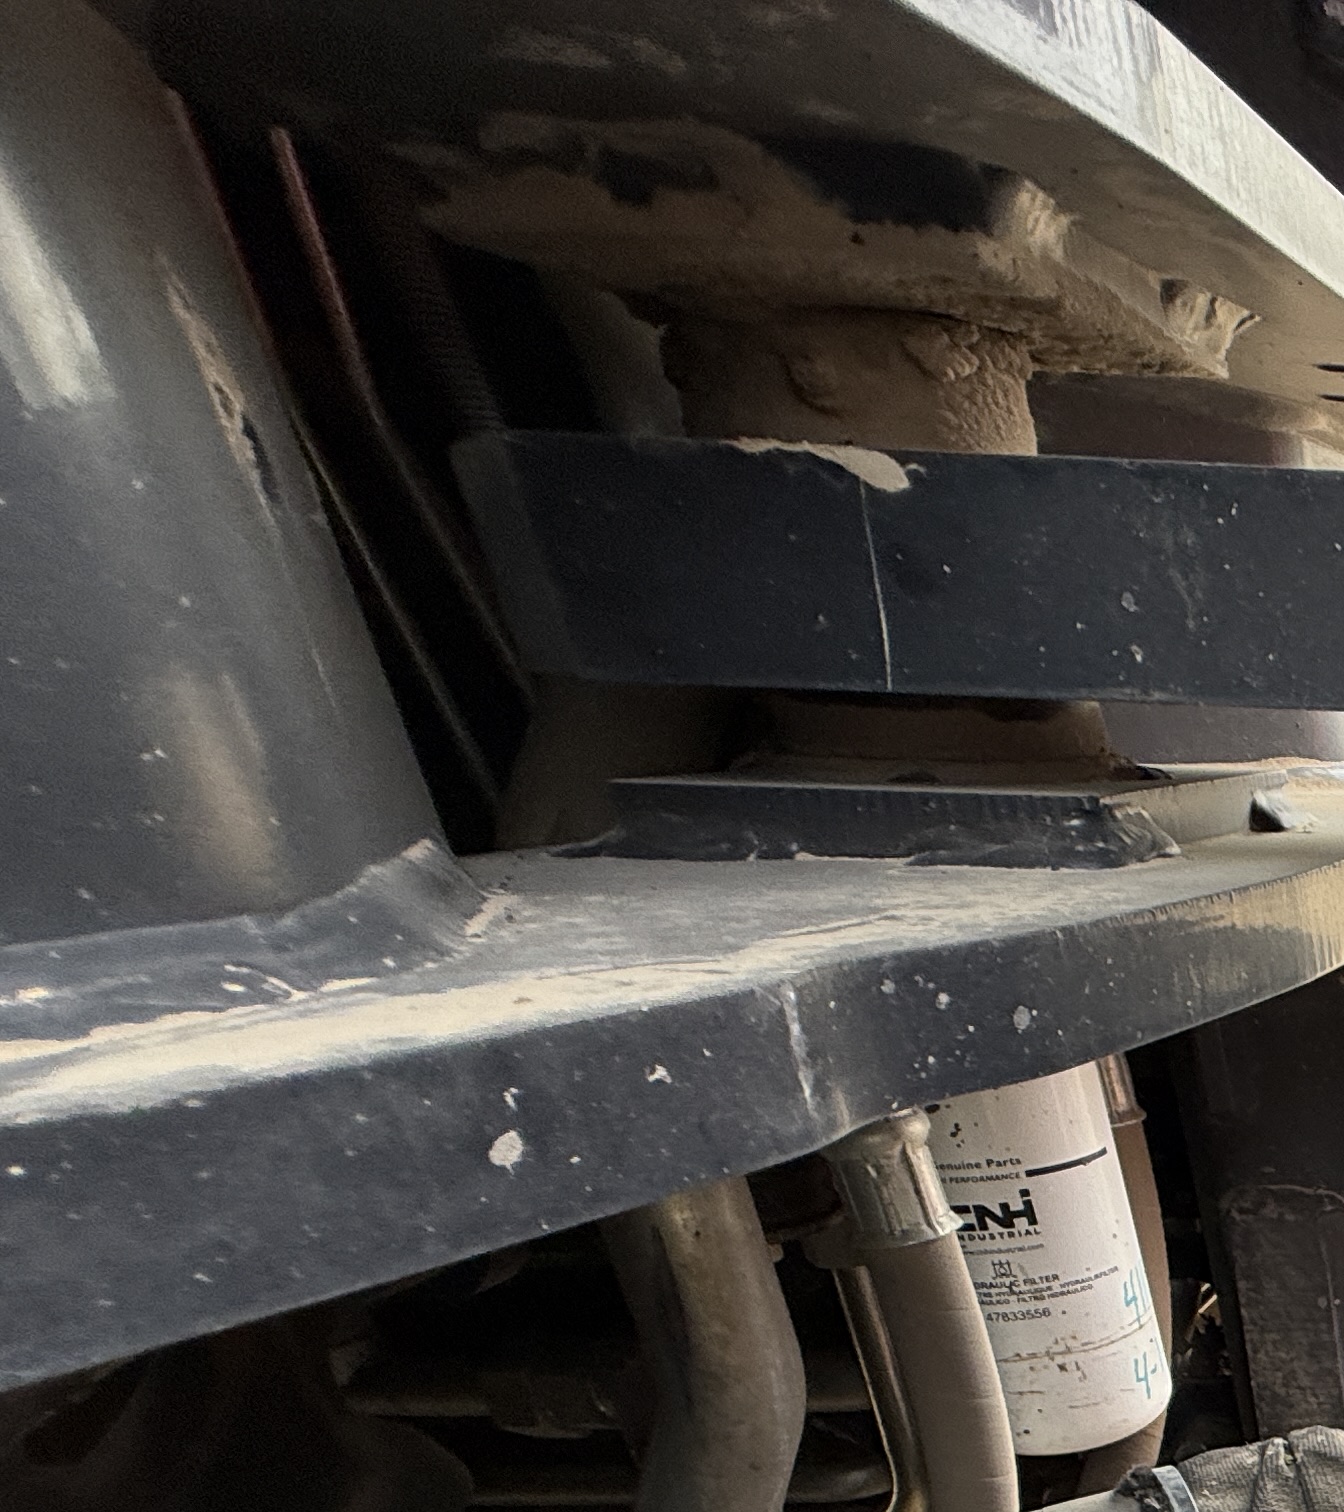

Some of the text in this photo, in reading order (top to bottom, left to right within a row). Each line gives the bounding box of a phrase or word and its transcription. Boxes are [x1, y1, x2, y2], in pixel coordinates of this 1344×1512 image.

[985, 1156, 1022, 1169] Parts
[949, 1172, 1021, 1184] PERFORMANCE
[957, 1227, 1042, 1242] NDUSTRIAL
[1023, 1273, 1060, 1287] FILTER
